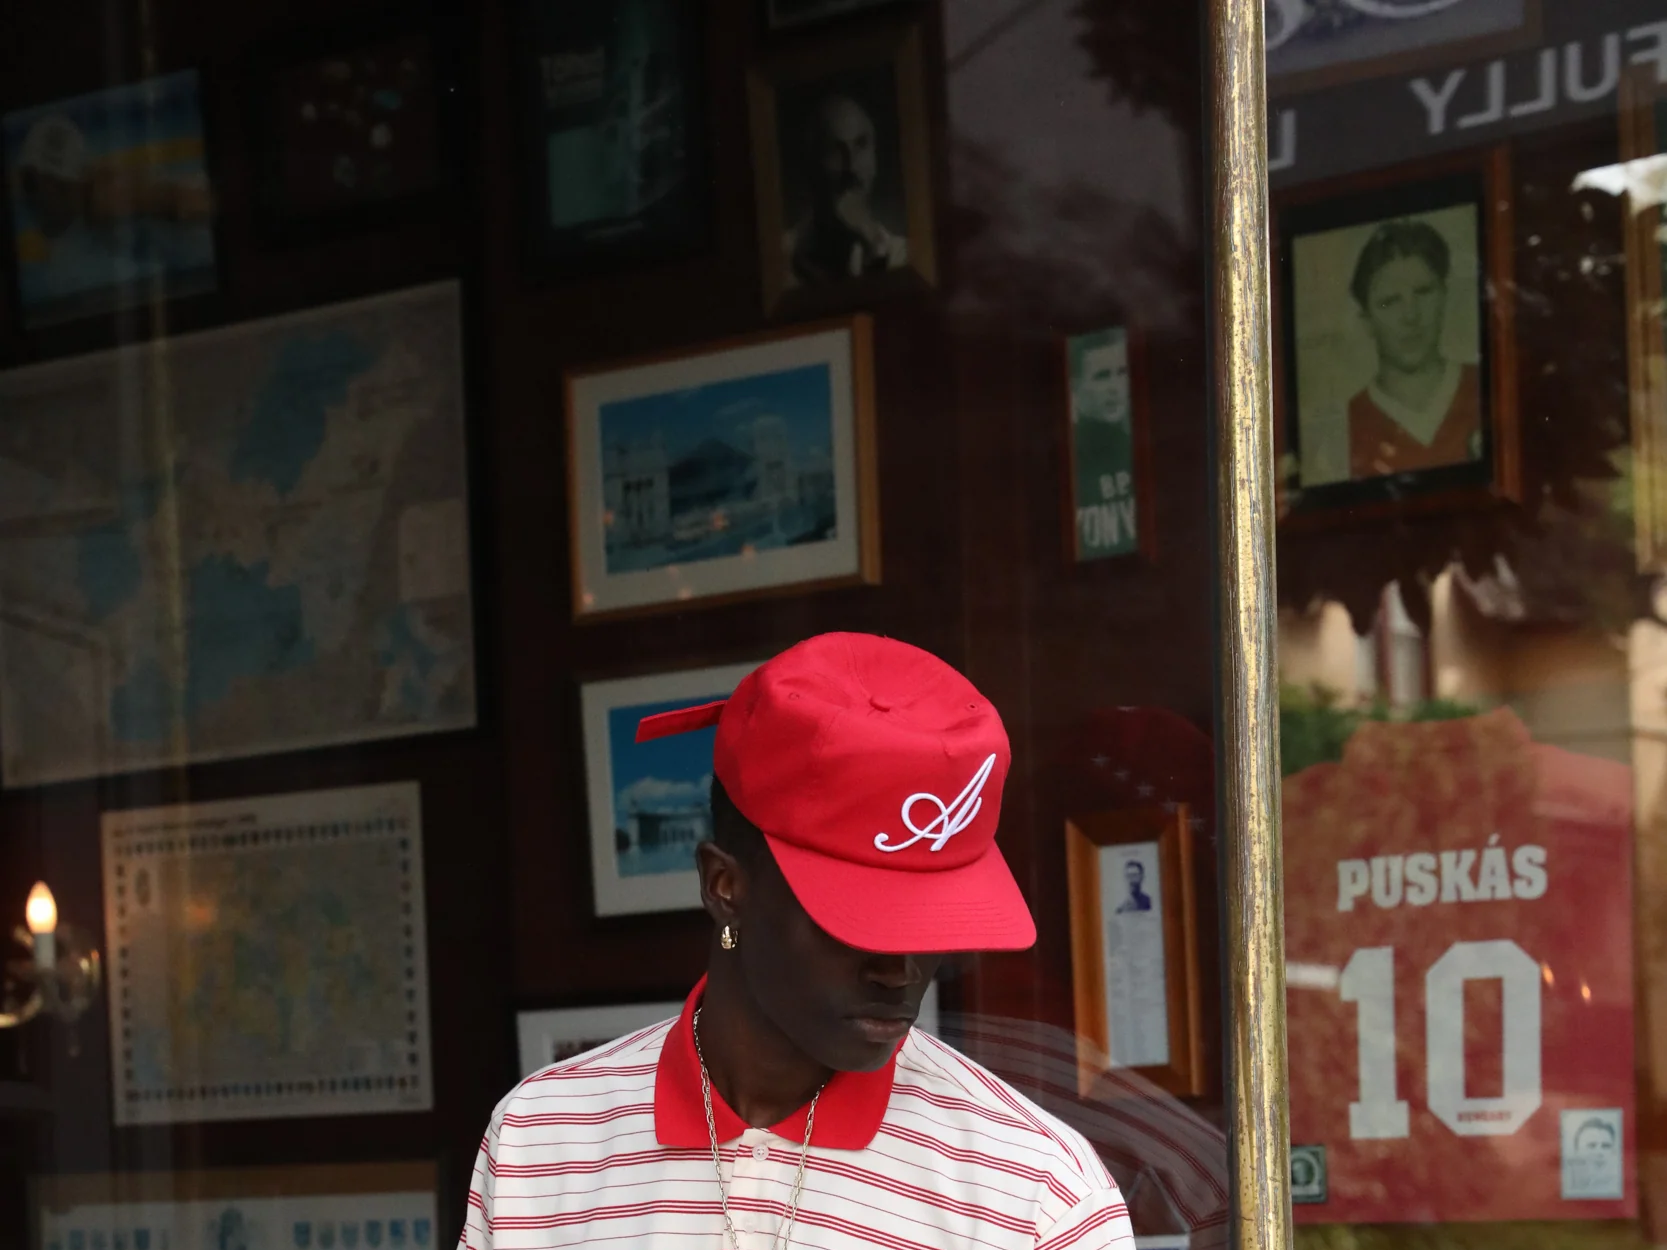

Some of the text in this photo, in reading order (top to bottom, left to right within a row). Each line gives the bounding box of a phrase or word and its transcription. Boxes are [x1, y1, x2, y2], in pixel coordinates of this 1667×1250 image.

[873, 752, 997, 853] A
[1337, 834, 1548, 913] PUSKÁS
[1339, 939, 1543, 1140] 10
